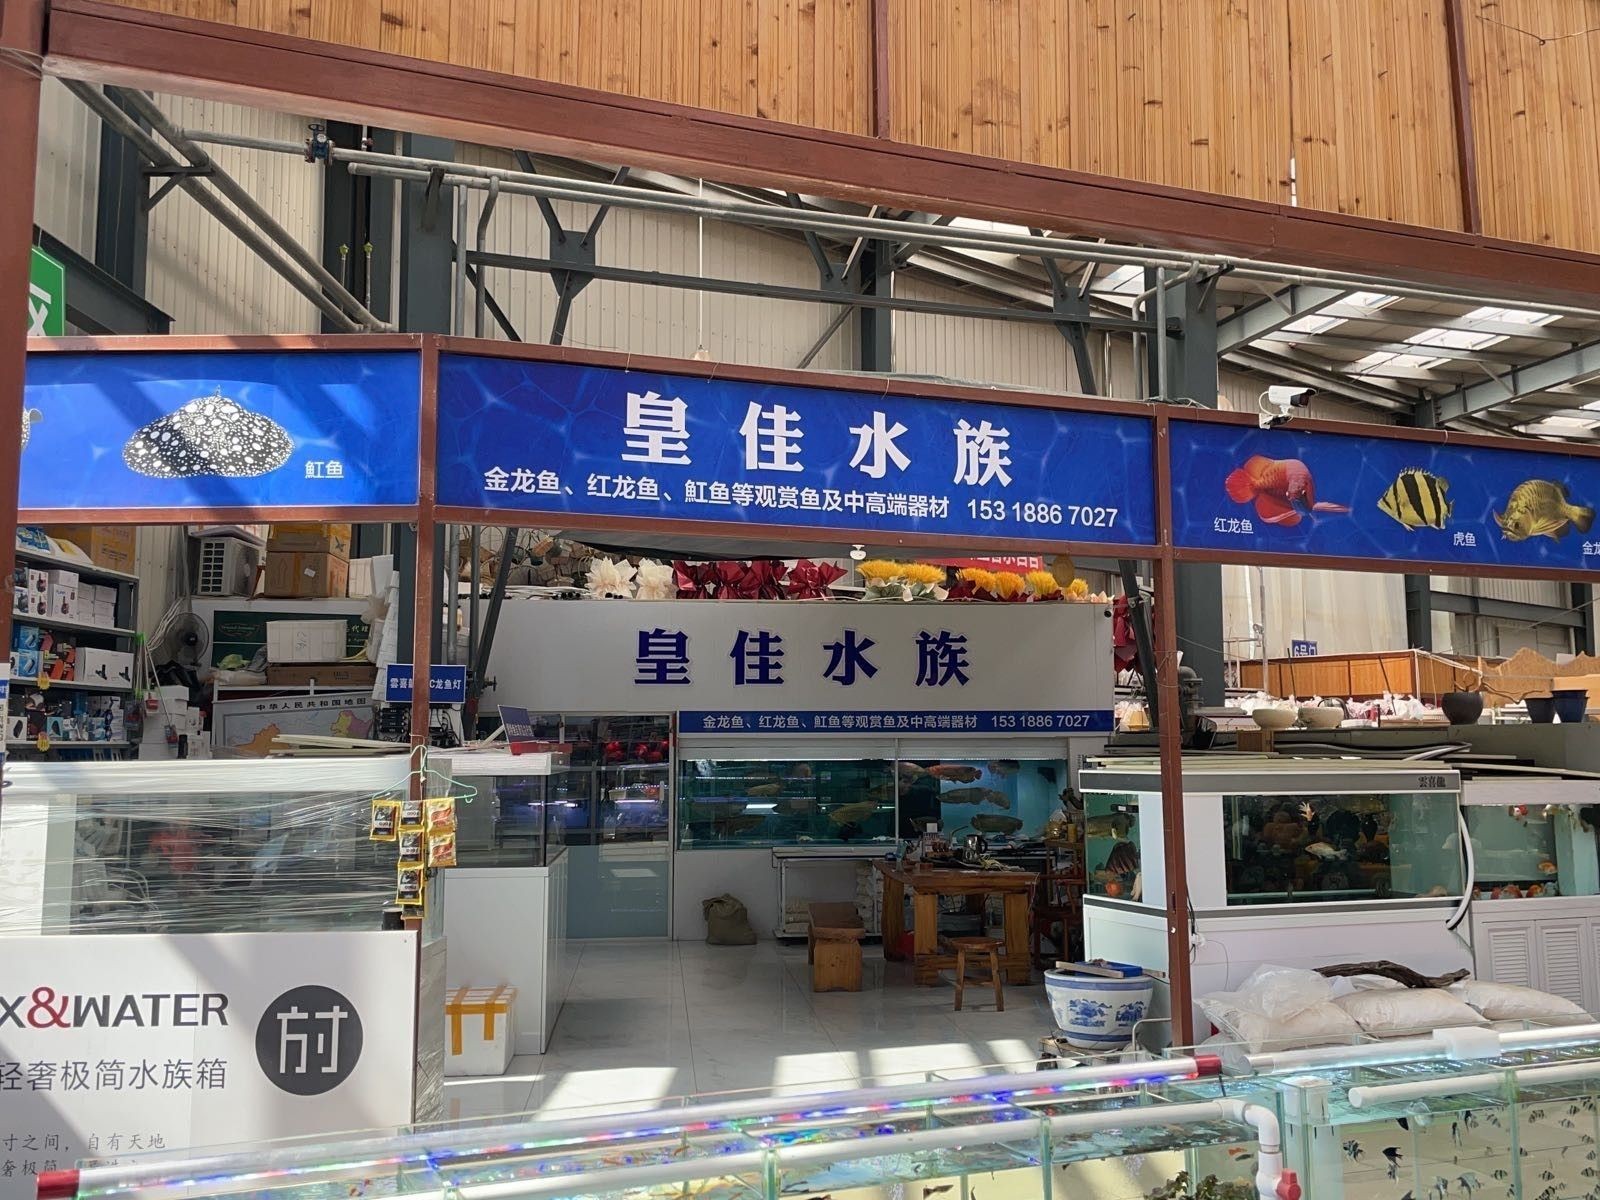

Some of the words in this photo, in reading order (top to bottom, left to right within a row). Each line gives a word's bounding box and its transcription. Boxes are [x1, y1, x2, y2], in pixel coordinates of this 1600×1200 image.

[621, 391, 1013, 488] 皇佳水族
[305, 460, 345, 479] 魟鱼
[968, 499, 1005, 521] 153
[1012, 502, 1062, 524] 1886
[1069, 506, 1118, 528] 7027
[1214, 517, 1254, 535] 红龙鱼
[1453, 532, 1477, 548] 虎鱼
[634, 628, 970, 687] 皇佳水族
[256, 697, 366, 711] 中华人民共和国地图
[991, 715, 1016, 727] 153
[1020, 715, 1053, 727] 1886
[1056, 715, 1090, 727] 7027
